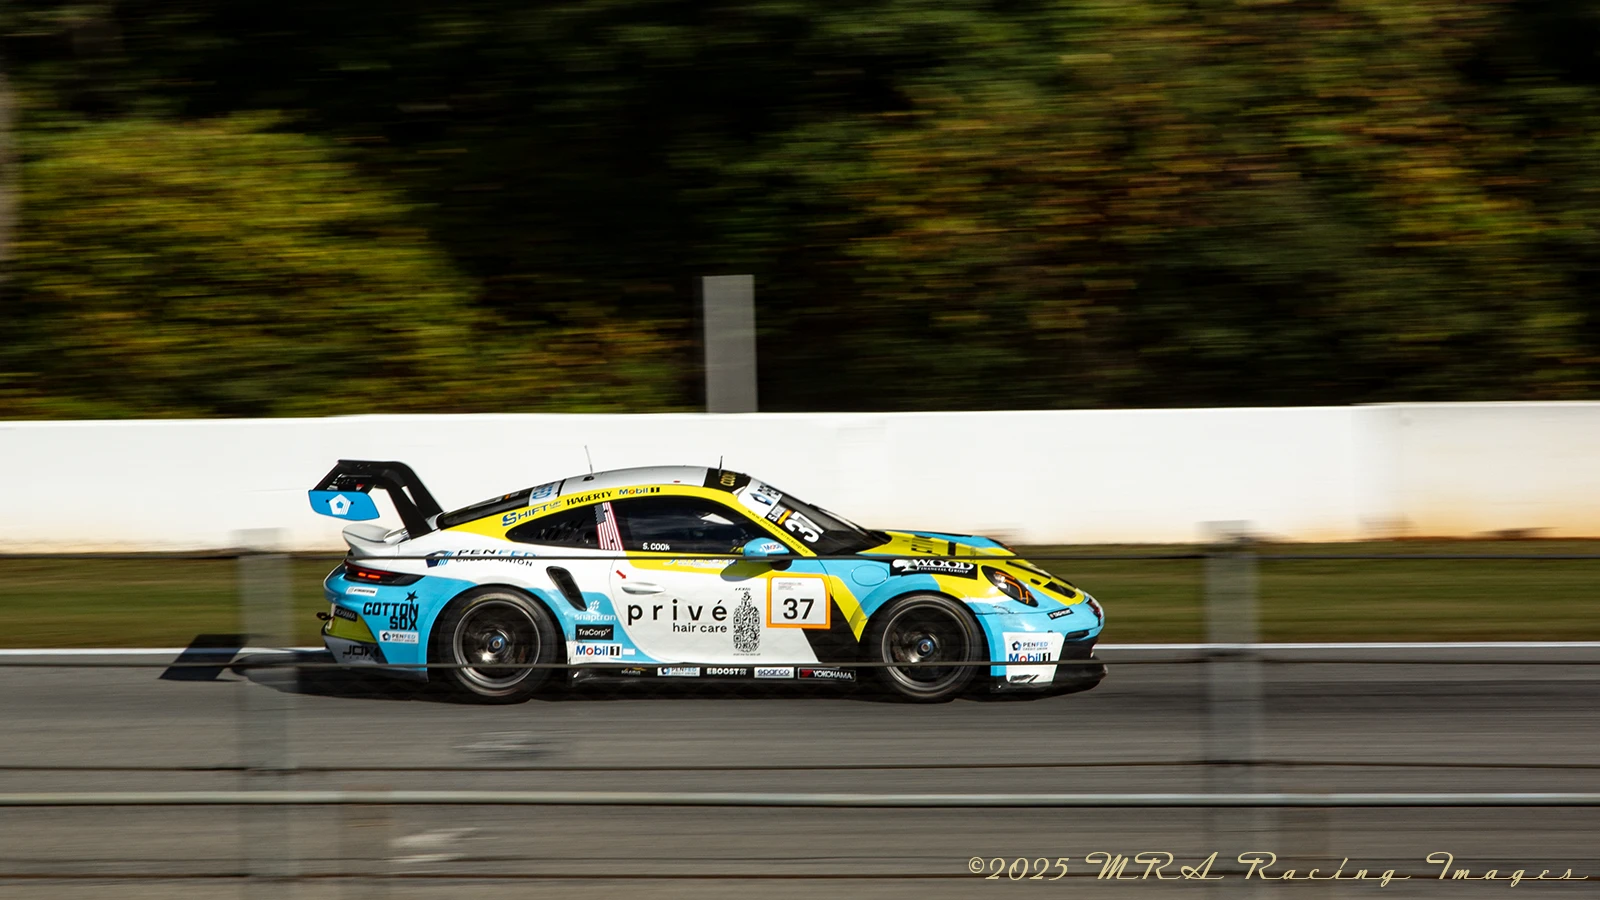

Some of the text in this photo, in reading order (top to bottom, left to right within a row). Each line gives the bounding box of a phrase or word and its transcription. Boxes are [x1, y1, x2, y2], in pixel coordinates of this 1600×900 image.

[618, 487, 648, 495] Mobil
[566, 491, 613, 506] HAGERTY
[502, 503, 548, 527] SHIFT
[784, 511, 824, 543] 37
[642, 542, 670, 551] S. COOK
[457, 549, 537, 557] PENFED
[912, 558, 974, 570] WOOD
[363, 602, 419, 618] COTTON
[627, 598, 727, 625] privé
[783, 598, 815, 620] 37
[574, 613, 616, 622] snaptron
[389, 616, 418, 630] SOX
[672, 622, 727, 633] hair care
[578, 628, 606, 637] TraCorp
[576, 646, 609, 656] Mobil
[1008, 653, 1041, 662] Mobil
[706, 667, 740, 675] EBOOST
[757, 669, 790, 677] sparco
[813, 670, 853, 680] YOKOHAMA
